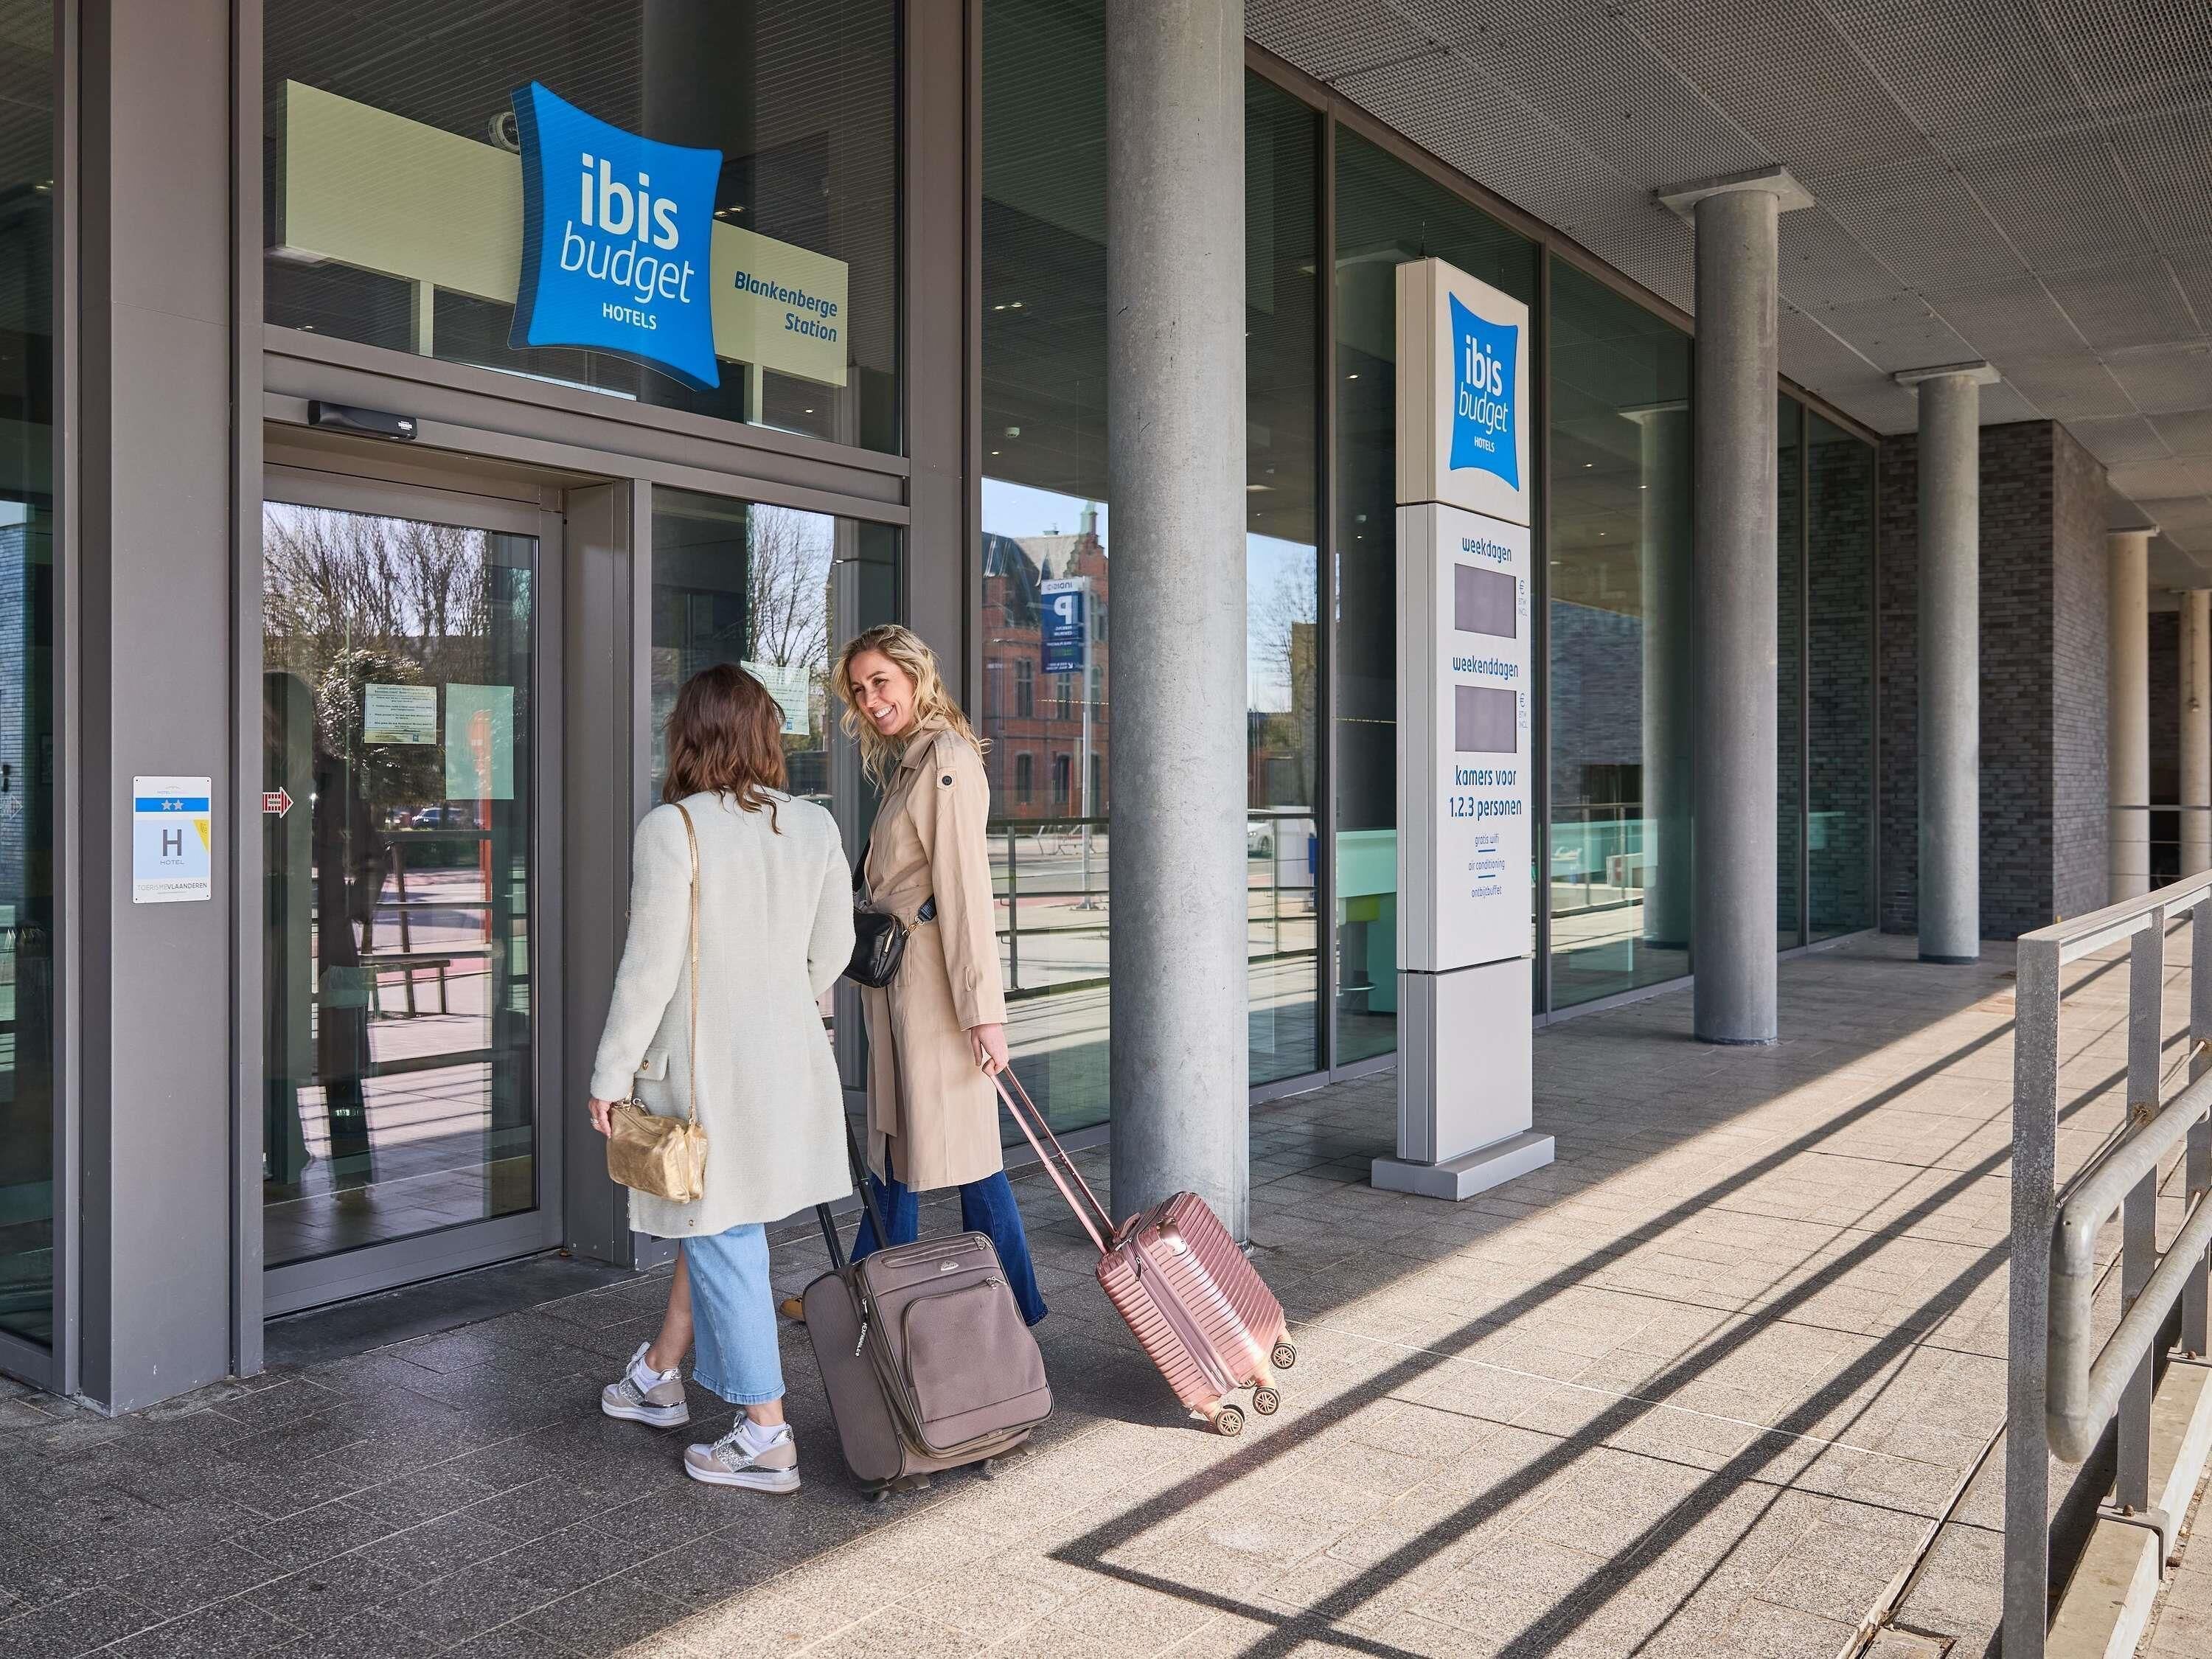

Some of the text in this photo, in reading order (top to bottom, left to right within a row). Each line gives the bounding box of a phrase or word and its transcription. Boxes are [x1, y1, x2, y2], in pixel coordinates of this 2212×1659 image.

[581, 152, 679, 250] ibis
[560, 220, 695, 305] budget
[734, 271, 838, 318] Blankenberge
[602, 302, 657, 330] HOTELS
[785, 313, 837, 342] Station
[1466, 334, 1503, 397] ibis
[1458, 381, 1509, 434] budget
[1474, 436, 1495, 453] HOTELS
[1461, 537, 1512, 563] weekdagen
[1453, 655, 1518, 681] weekenddagen
[1455, 765, 1517, 786] kamers voor
[1478, 799, 1522, 821] personen
[163, 830, 182, 856] H
[1475, 835, 1489, 847] gratis
